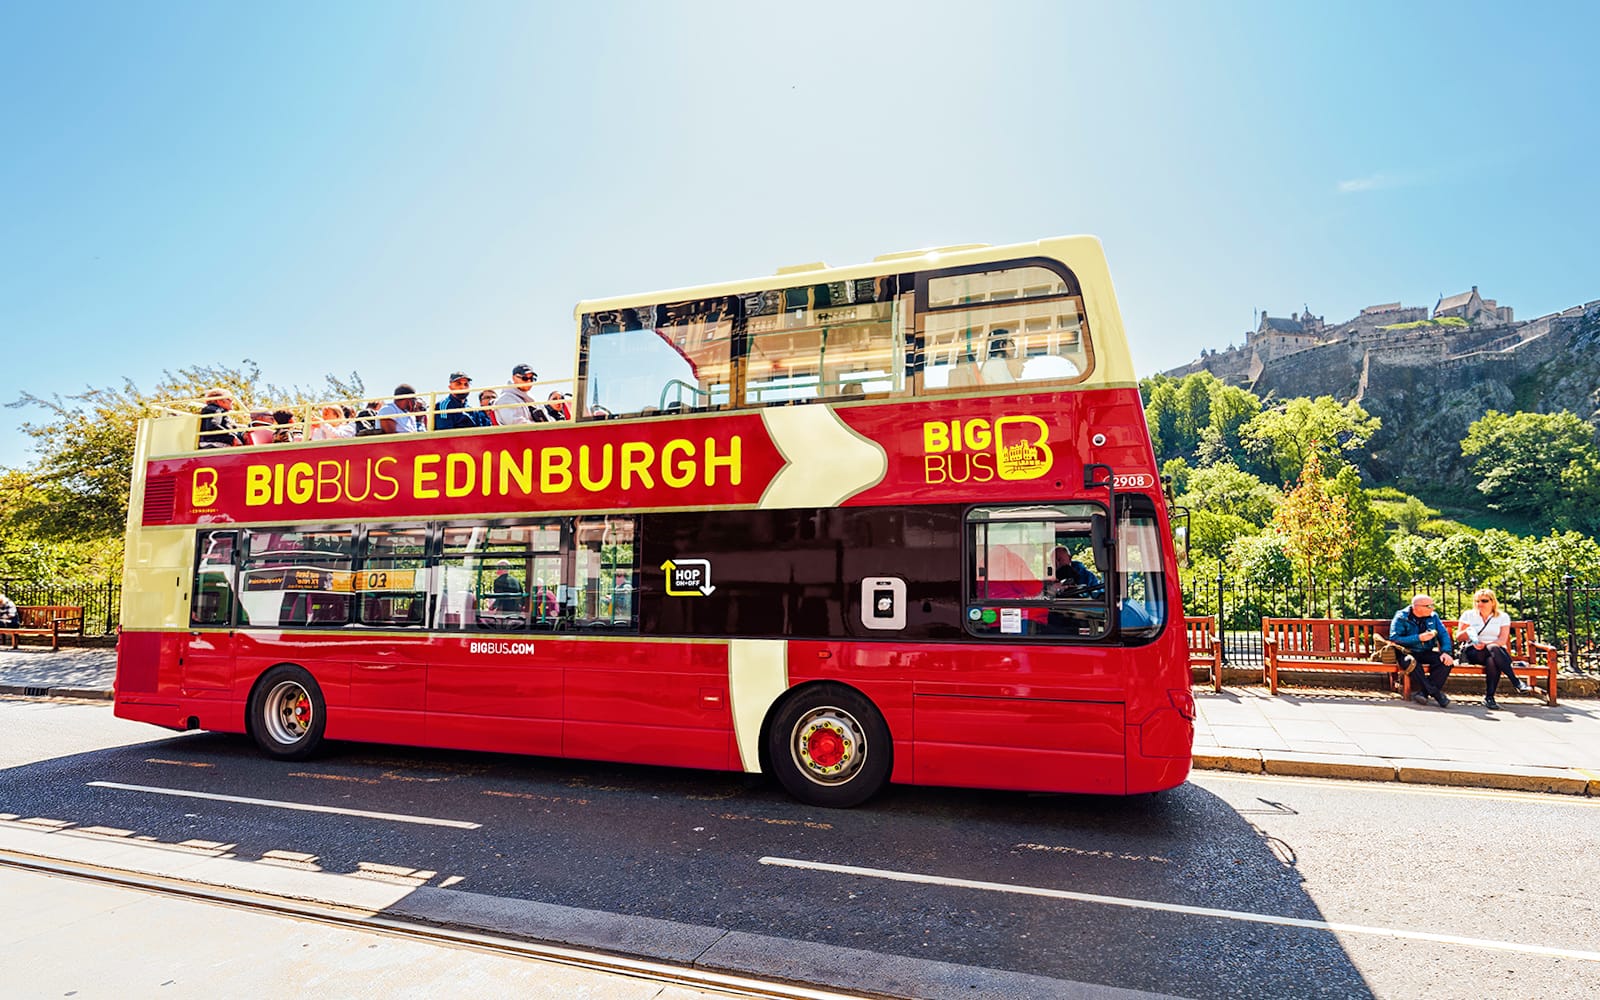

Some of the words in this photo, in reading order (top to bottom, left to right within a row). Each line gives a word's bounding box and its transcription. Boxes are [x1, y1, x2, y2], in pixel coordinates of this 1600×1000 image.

[923, 418, 992, 453] BIG
[412, 435, 742, 499] EDINBURGH
[924, 452, 994, 484] BUS
[1112, 476, 1145, 487] 2908
[675, 569, 701, 580] HOP
[470, 642, 535, 655] BIGBUS.COM
